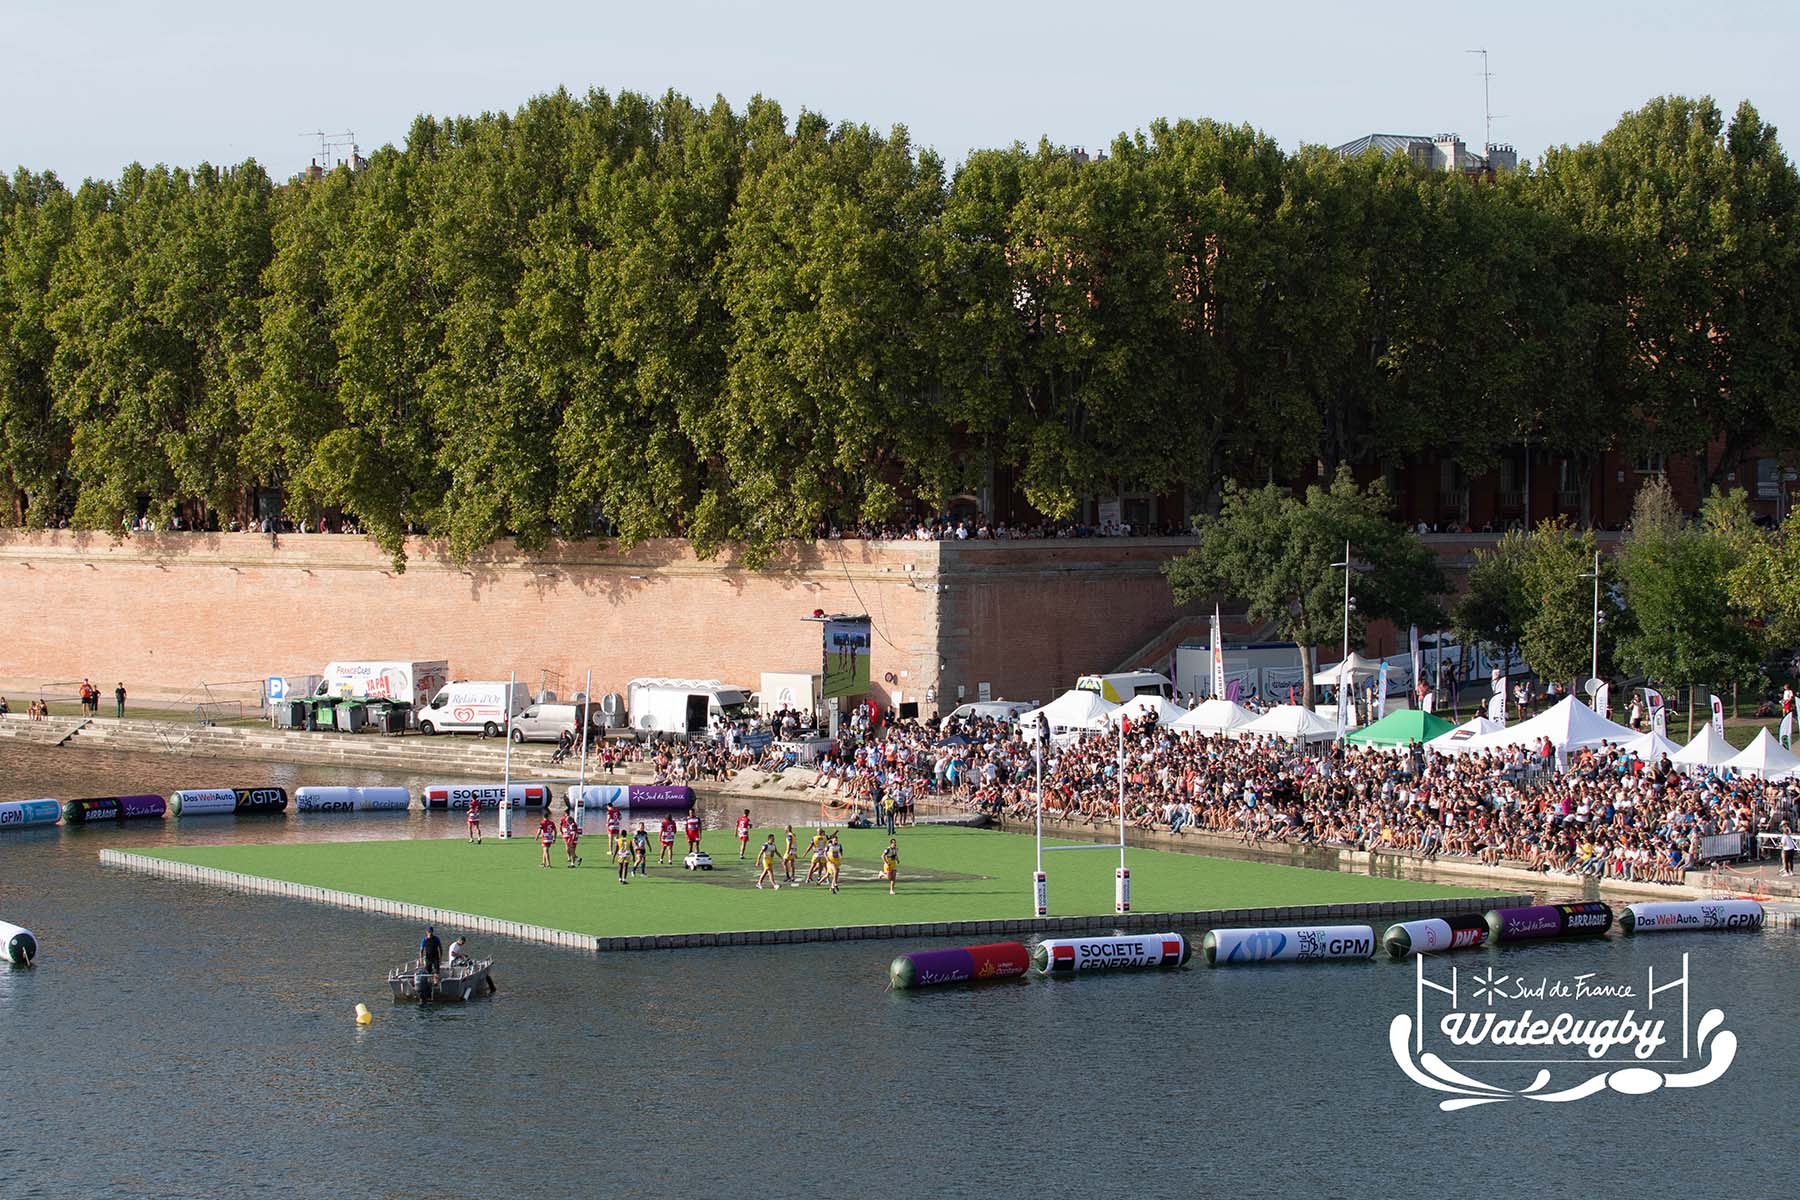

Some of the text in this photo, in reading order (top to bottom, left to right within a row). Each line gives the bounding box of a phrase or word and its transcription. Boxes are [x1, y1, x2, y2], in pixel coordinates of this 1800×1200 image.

[452, 694, 477, 704] Relais
[183, 794, 198, 802] Das
[644, 792, 656, 800] Sud
[664, 790, 685, 800] France
[322, 801, 354, 811] GPM
[1, 810, 23, 823] GPM
[1568, 914, 1607, 927] BARRAQUE
[1638, 916, 1655, 926] Das
[1727, 914, 1761, 927] GPM
[1080, 943, 1144, 957] SOCIETE
[1329, 939, 1369, 955] GPM
[1080, 957, 1156, 969] GENERALE
